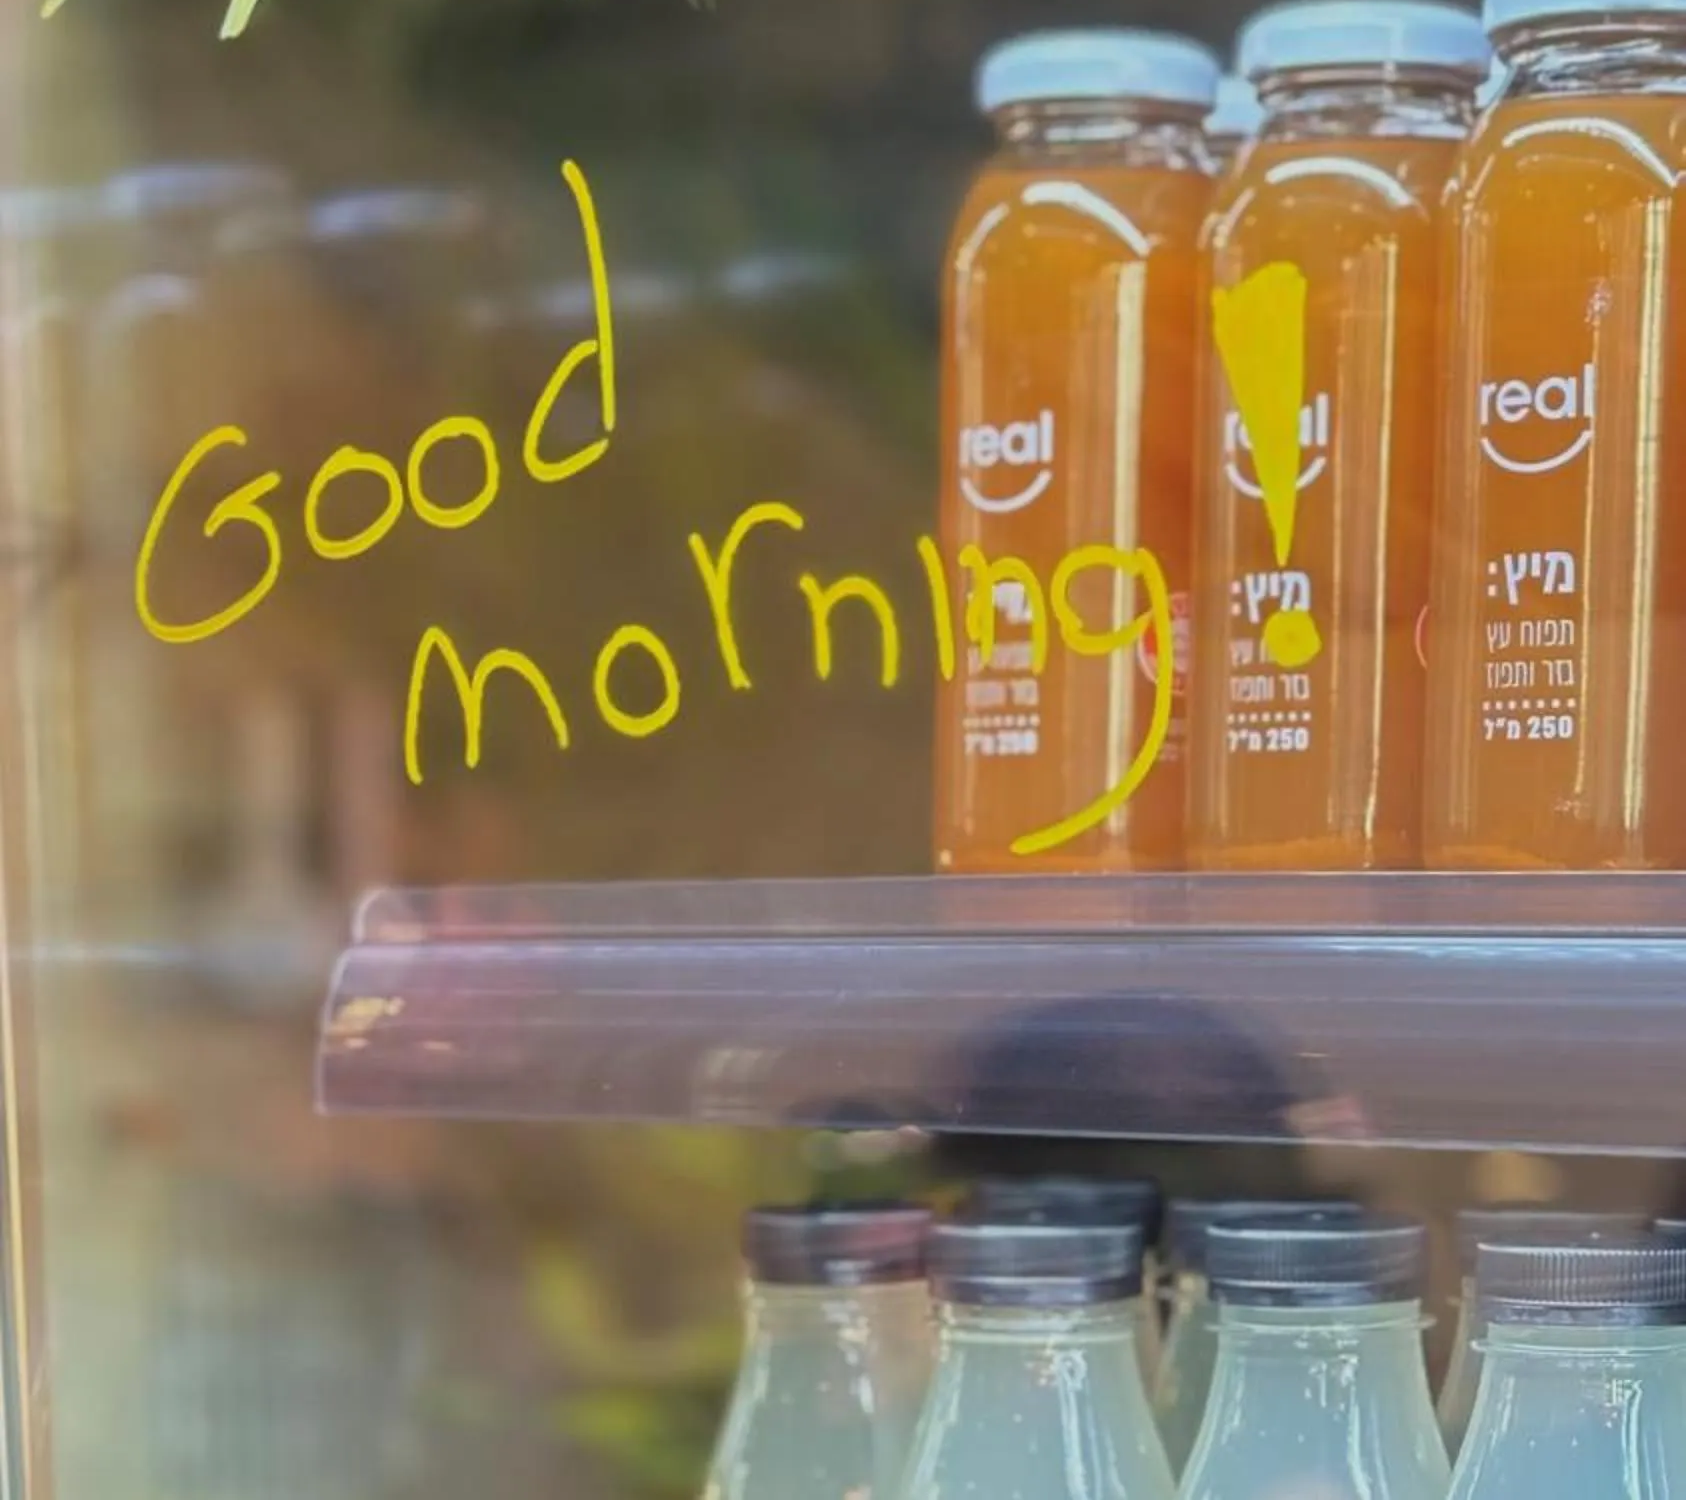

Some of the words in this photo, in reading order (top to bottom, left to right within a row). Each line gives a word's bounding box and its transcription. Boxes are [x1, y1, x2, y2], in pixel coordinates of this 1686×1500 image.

[1480, 363, 1595, 425] real
[1224, 393, 1329, 453] rl
[959, 409, 1054, 468] real
[1486, 622, 1512, 653] עץ
[1519, 619, 1575, 647] תפוח
[1542, 660, 1575, 687] גזר
[1266, 727, 1310, 752] 250
[1527, 715, 1574, 740] 250
